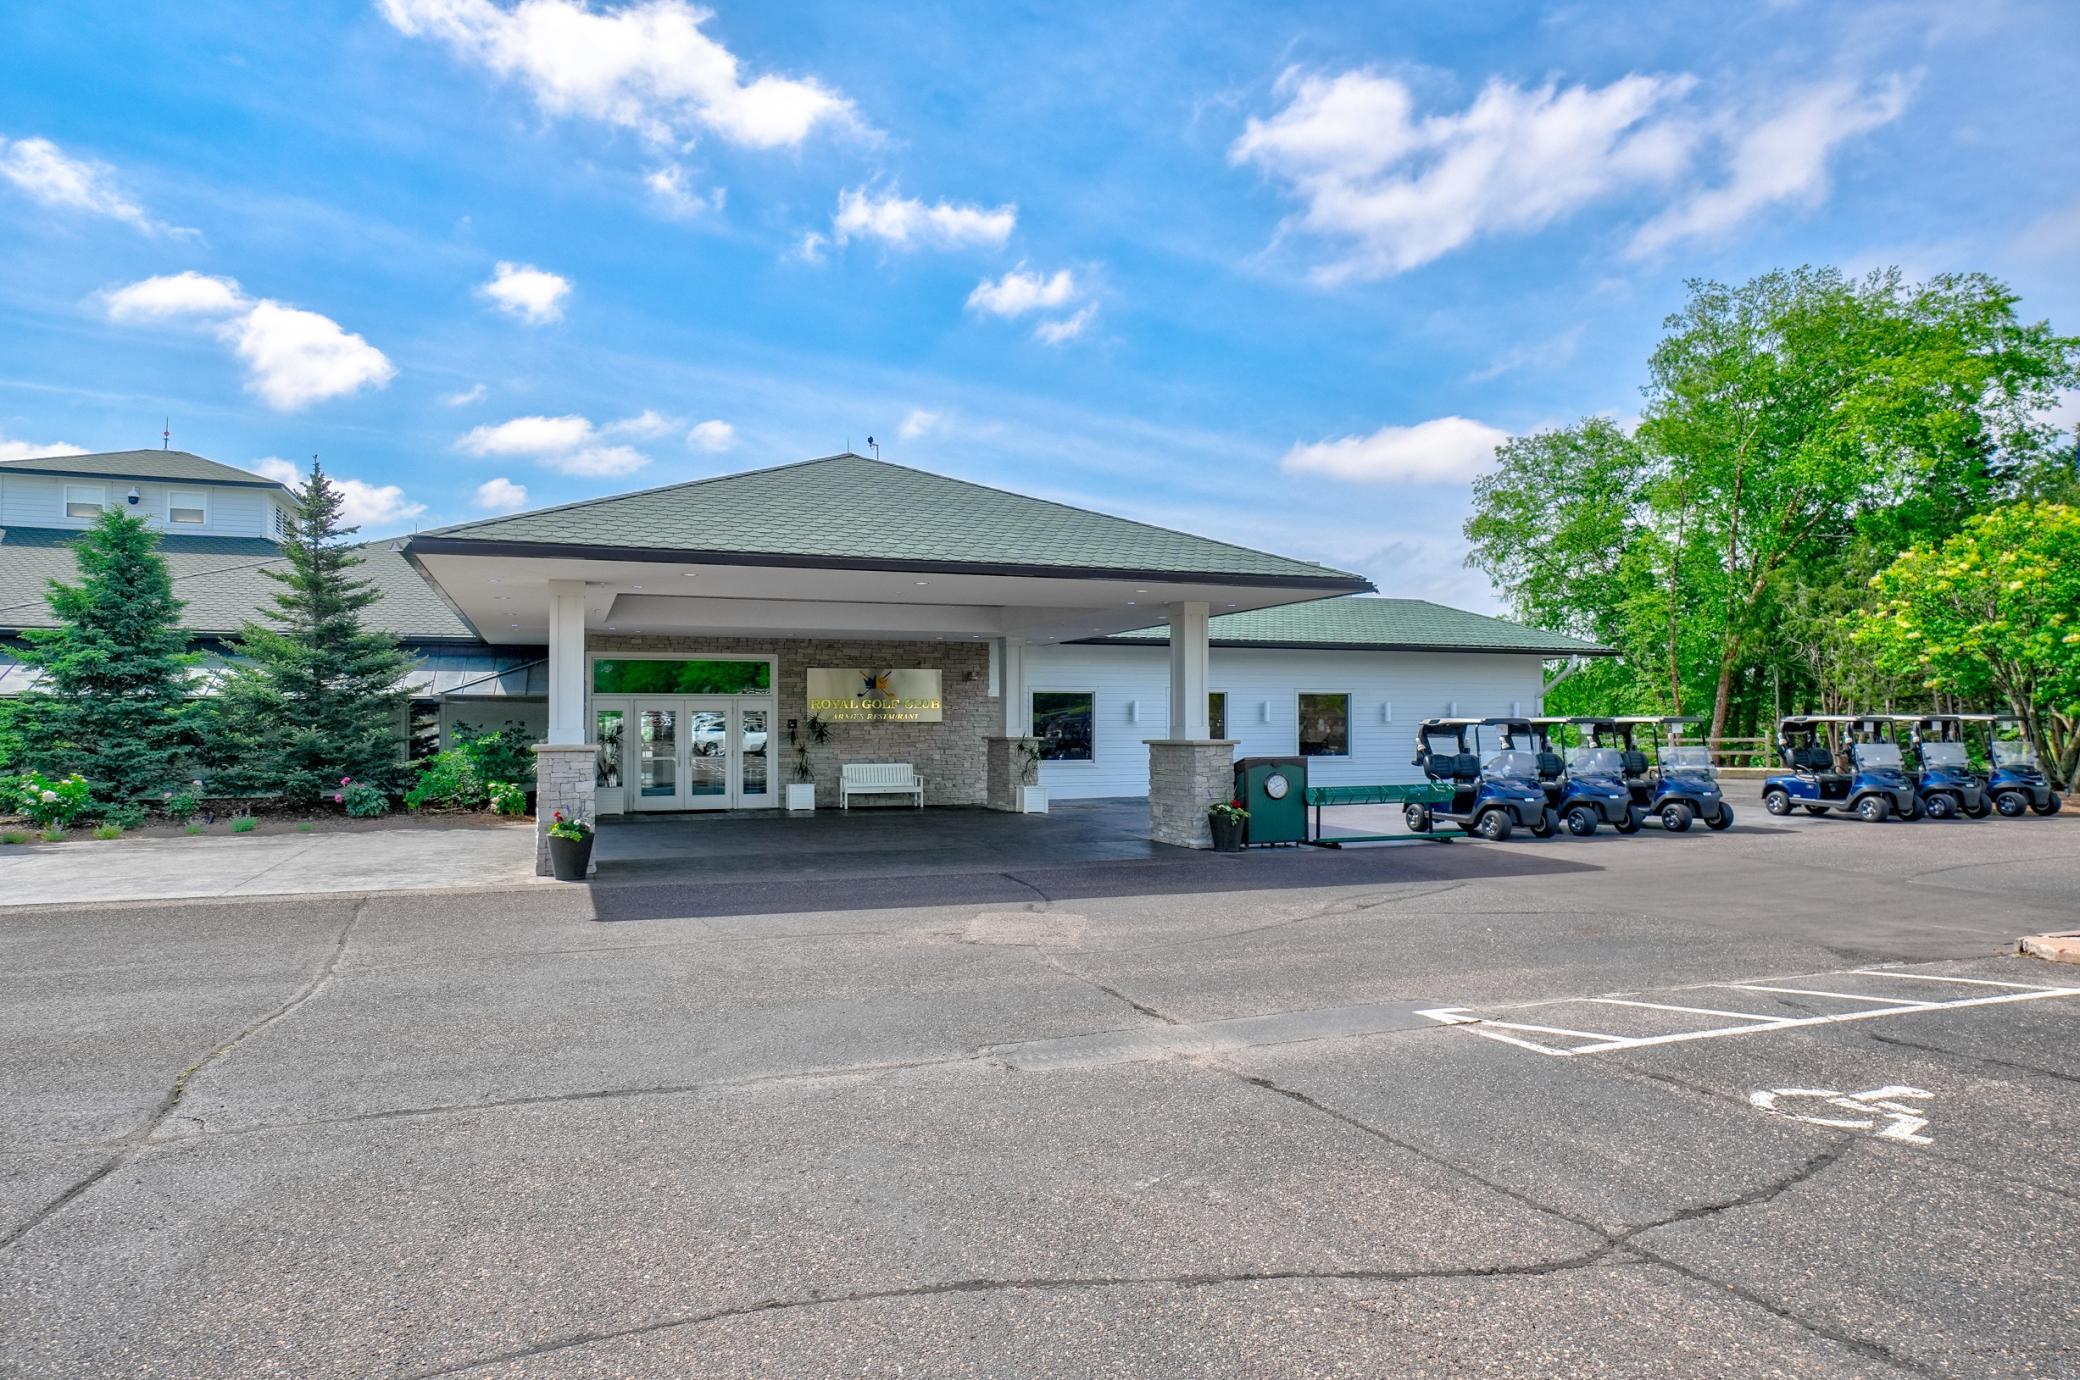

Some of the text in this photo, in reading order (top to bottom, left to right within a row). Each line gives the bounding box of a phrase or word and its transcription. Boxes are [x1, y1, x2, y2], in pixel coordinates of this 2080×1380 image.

[811, 699, 940, 710] ROYAL GOLF CLUB
